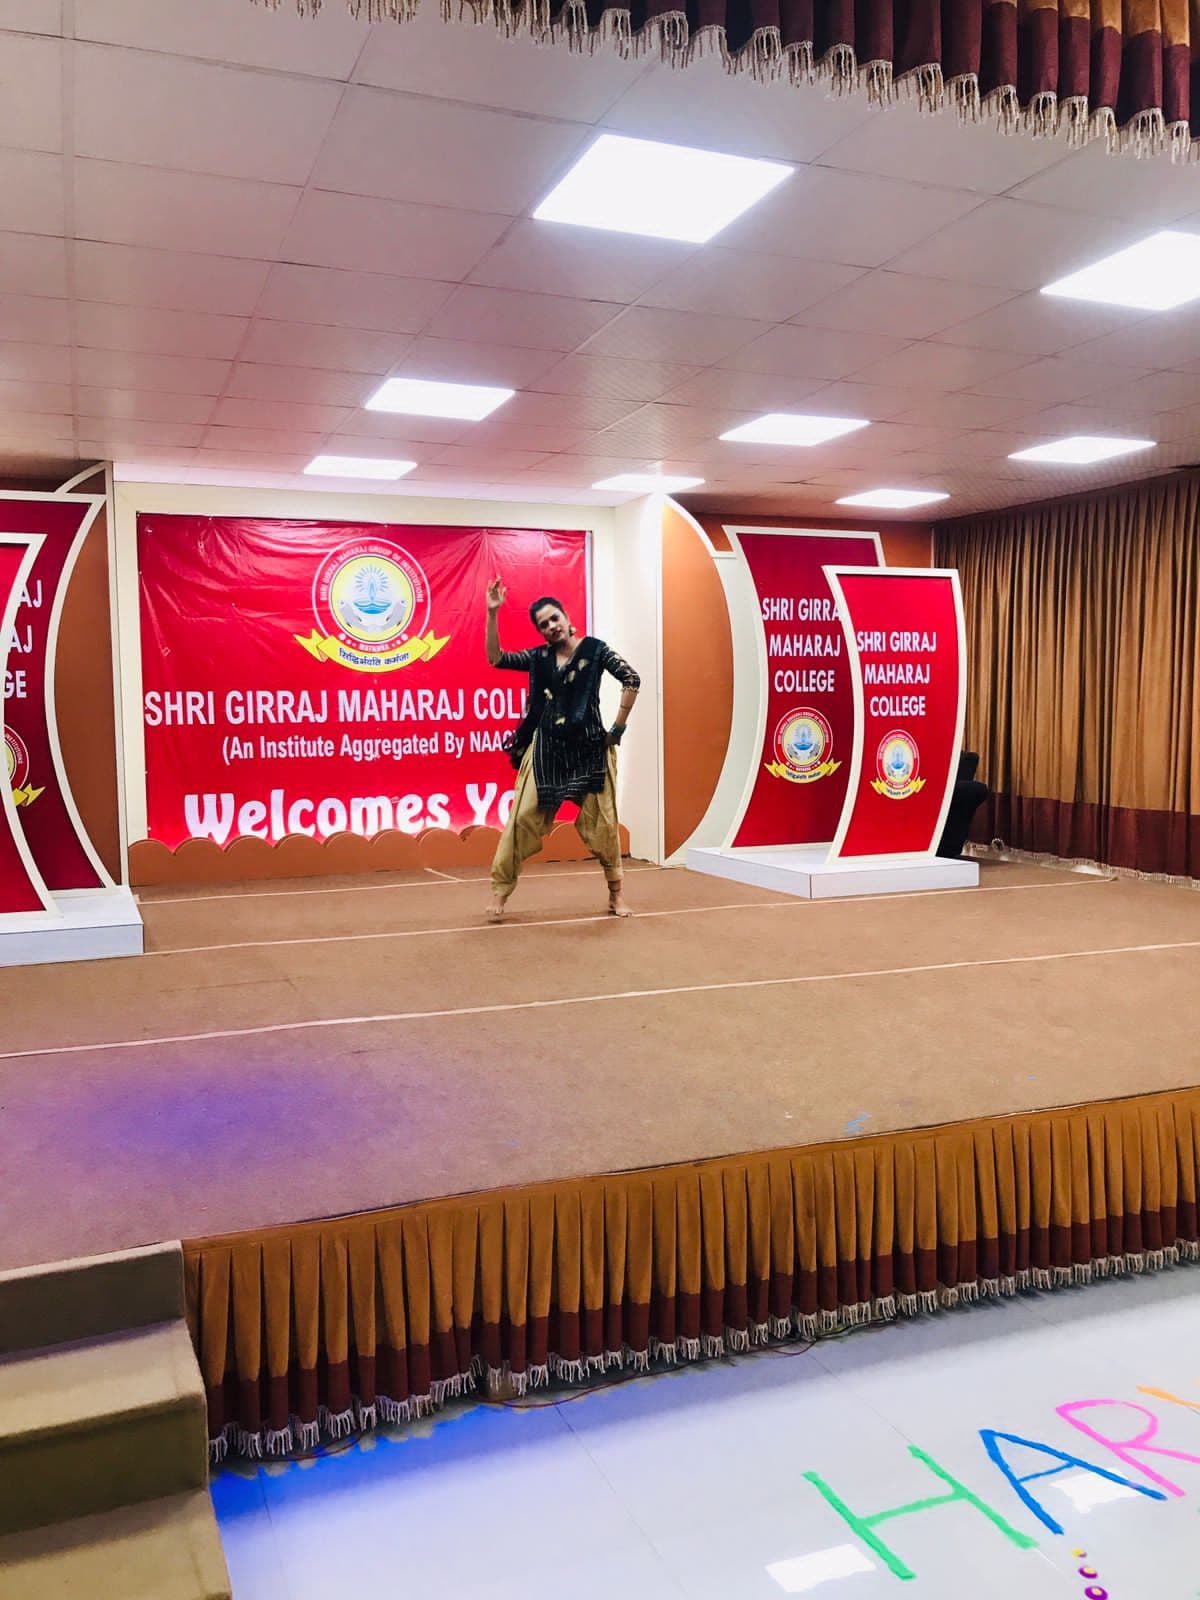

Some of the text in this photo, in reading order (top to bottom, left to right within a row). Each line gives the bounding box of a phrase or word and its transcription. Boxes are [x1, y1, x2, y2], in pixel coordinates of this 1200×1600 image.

[368, 545, 392, 556] GROUP
[762, 597, 794, 621] SHRI
[769, 634, 841, 657] MAHARAJ
[857, 631, 937, 652] SHRI GIRRAJ
[774, 669, 836, 693] COLLEGE
[864, 663, 931, 685] MAHARAJ
[144, 690, 215, 726] SHRI
[225, 690, 328, 725] GIRRAJ
[337, 689, 465, 722] MAHARAJ
[870, 695, 926, 717] COLLEGE
[222, 735, 254, 766] (An
[260, 735, 334, 759] Institute
[340, 731, 439, 762] Aggregated
[444, 731, 465, 759] By
[184, 788, 451, 844] Welcomes
[801, 1383, 1200, 1581] HAR
